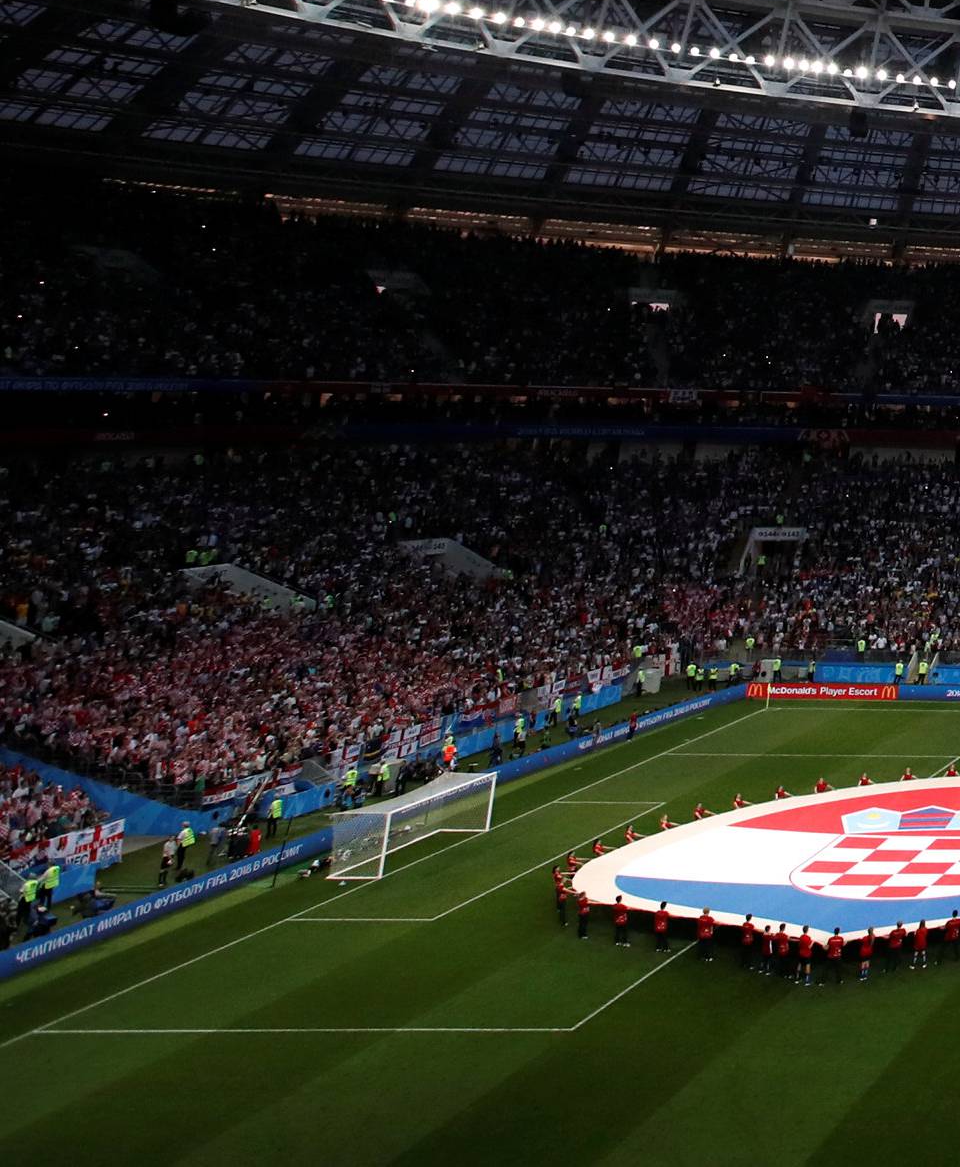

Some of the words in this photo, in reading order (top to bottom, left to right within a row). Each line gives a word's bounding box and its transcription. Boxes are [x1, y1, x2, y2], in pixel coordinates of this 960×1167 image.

[768, 686, 817, 695] McDonald's
[820, 686, 847, 697] Player
[848, 687, 878, 696] Escort
[16, 924, 96, 963] ЧЕМПИОНАТ
[97, 909, 133, 933] МИРА
[134, 902, 152, 919] ПО
[154, 880, 205, 910] ФУТБОЛУ
[206, 872, 229, 890] FIFA
[229, 863, 252, 882] 2018
[252, 860, 261, 872] В
